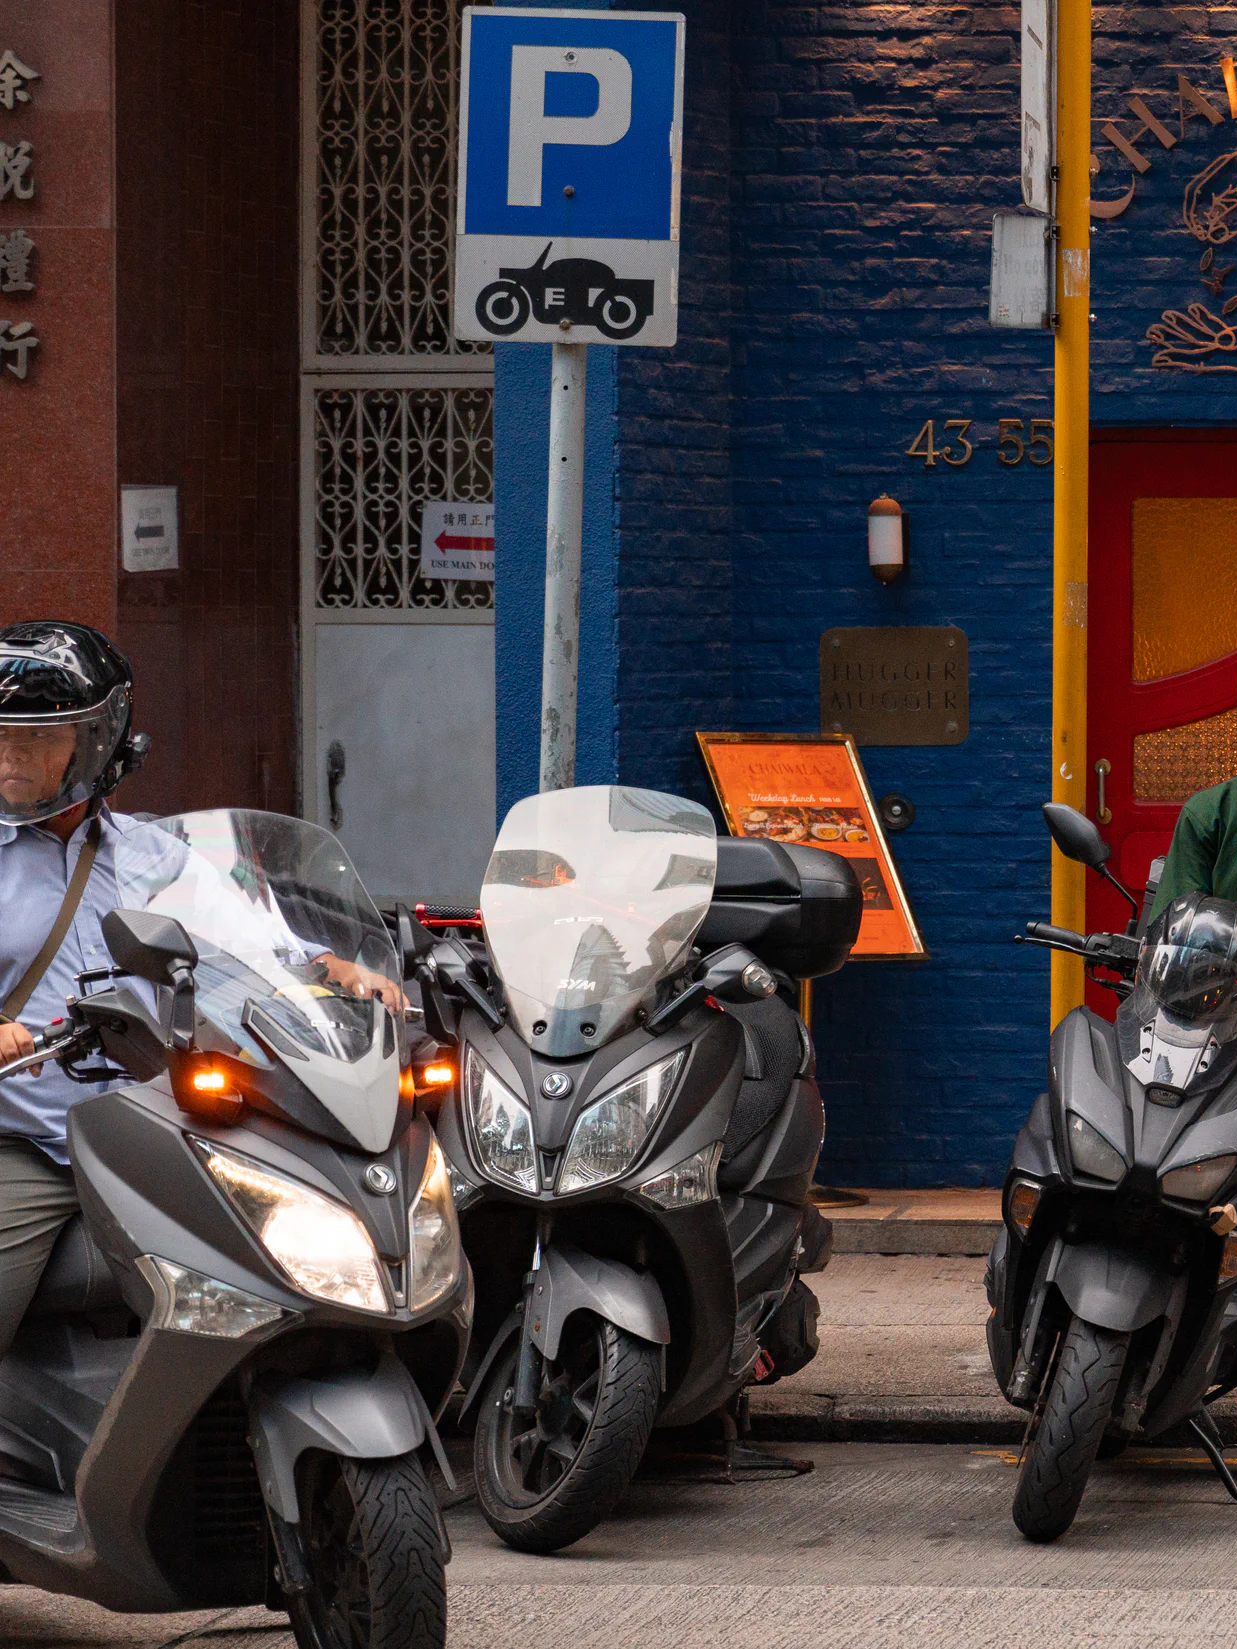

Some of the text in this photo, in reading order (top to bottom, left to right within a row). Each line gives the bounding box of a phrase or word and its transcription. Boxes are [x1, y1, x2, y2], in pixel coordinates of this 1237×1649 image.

[506, 44, 633, 207] P
[904, 418, 1055, 466] 43 55
[431, 560, 448, 569] USE
[451, 561, 476, 569] MAIN
[833, 662, 956, 681] HUGGER
[832, 690, 957, 711] MUGGER
[748, 793, 789, 804] Weekday
[790, 794, 816, 802] Lunch
[556, 979, 596, 991] SYM
